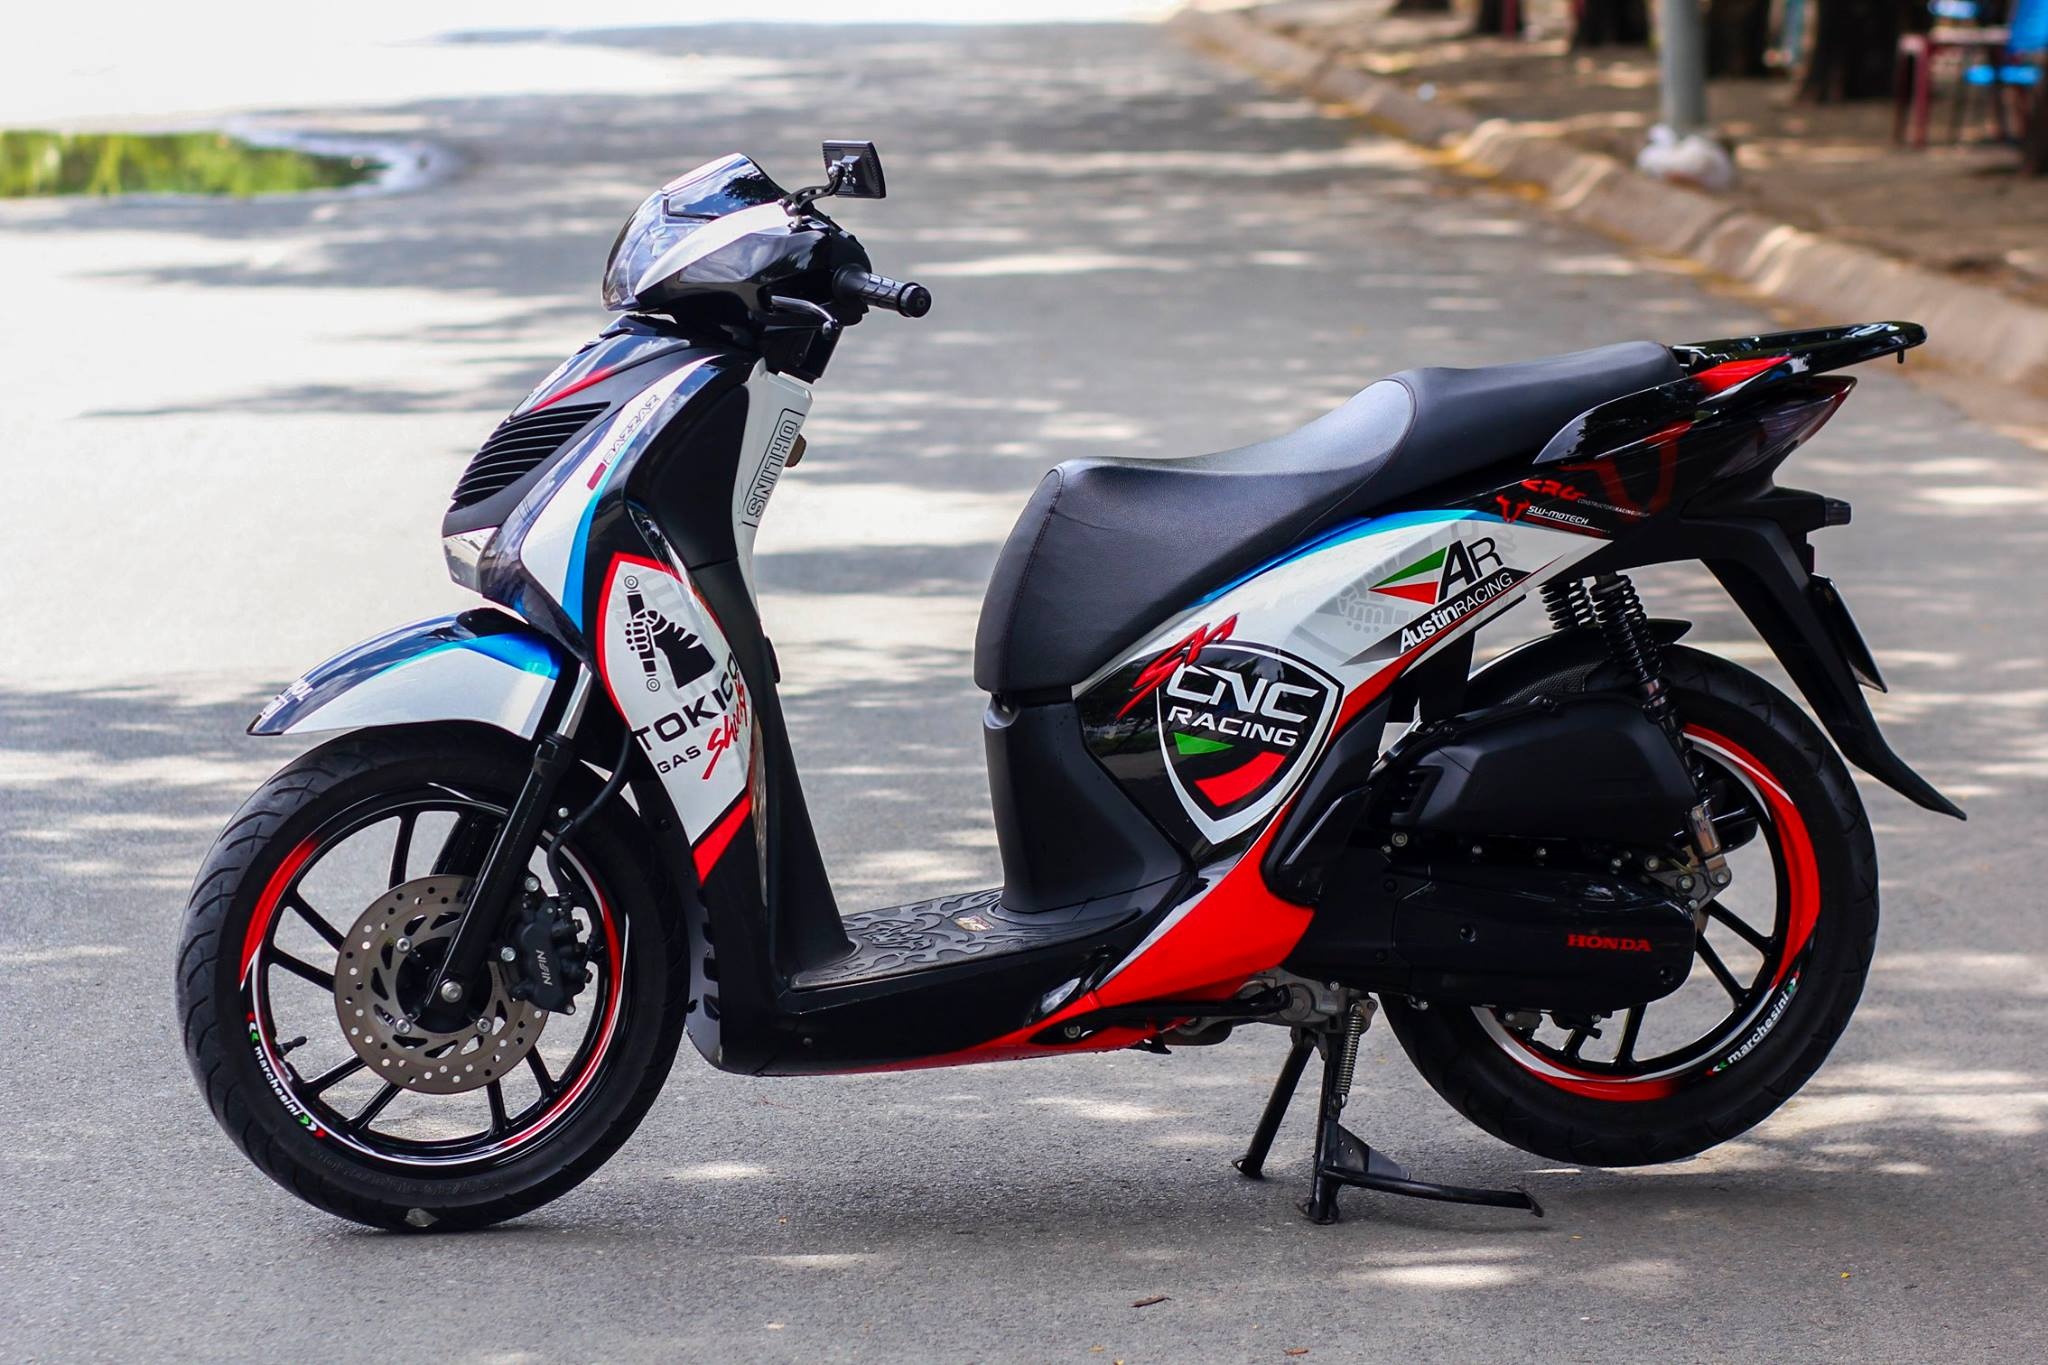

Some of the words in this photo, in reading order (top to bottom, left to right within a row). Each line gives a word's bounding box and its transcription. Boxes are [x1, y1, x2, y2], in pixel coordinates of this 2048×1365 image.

[1527, 505, 1590, 525] SW-MOTECH
[1438, 537, 1504, 603] AR
[631, 652, 739, 751] TOKICO
[1166, 662, 1319, 723] CNC
[1167, 705, 1299, 747] RACING
[657, 745, 701, 774] GAS
[1567, 934, 1652, 952] HONDA
[1727, 990, 1789, 1064] marchesini
[254, 1045, 304, 1116] marchesini
